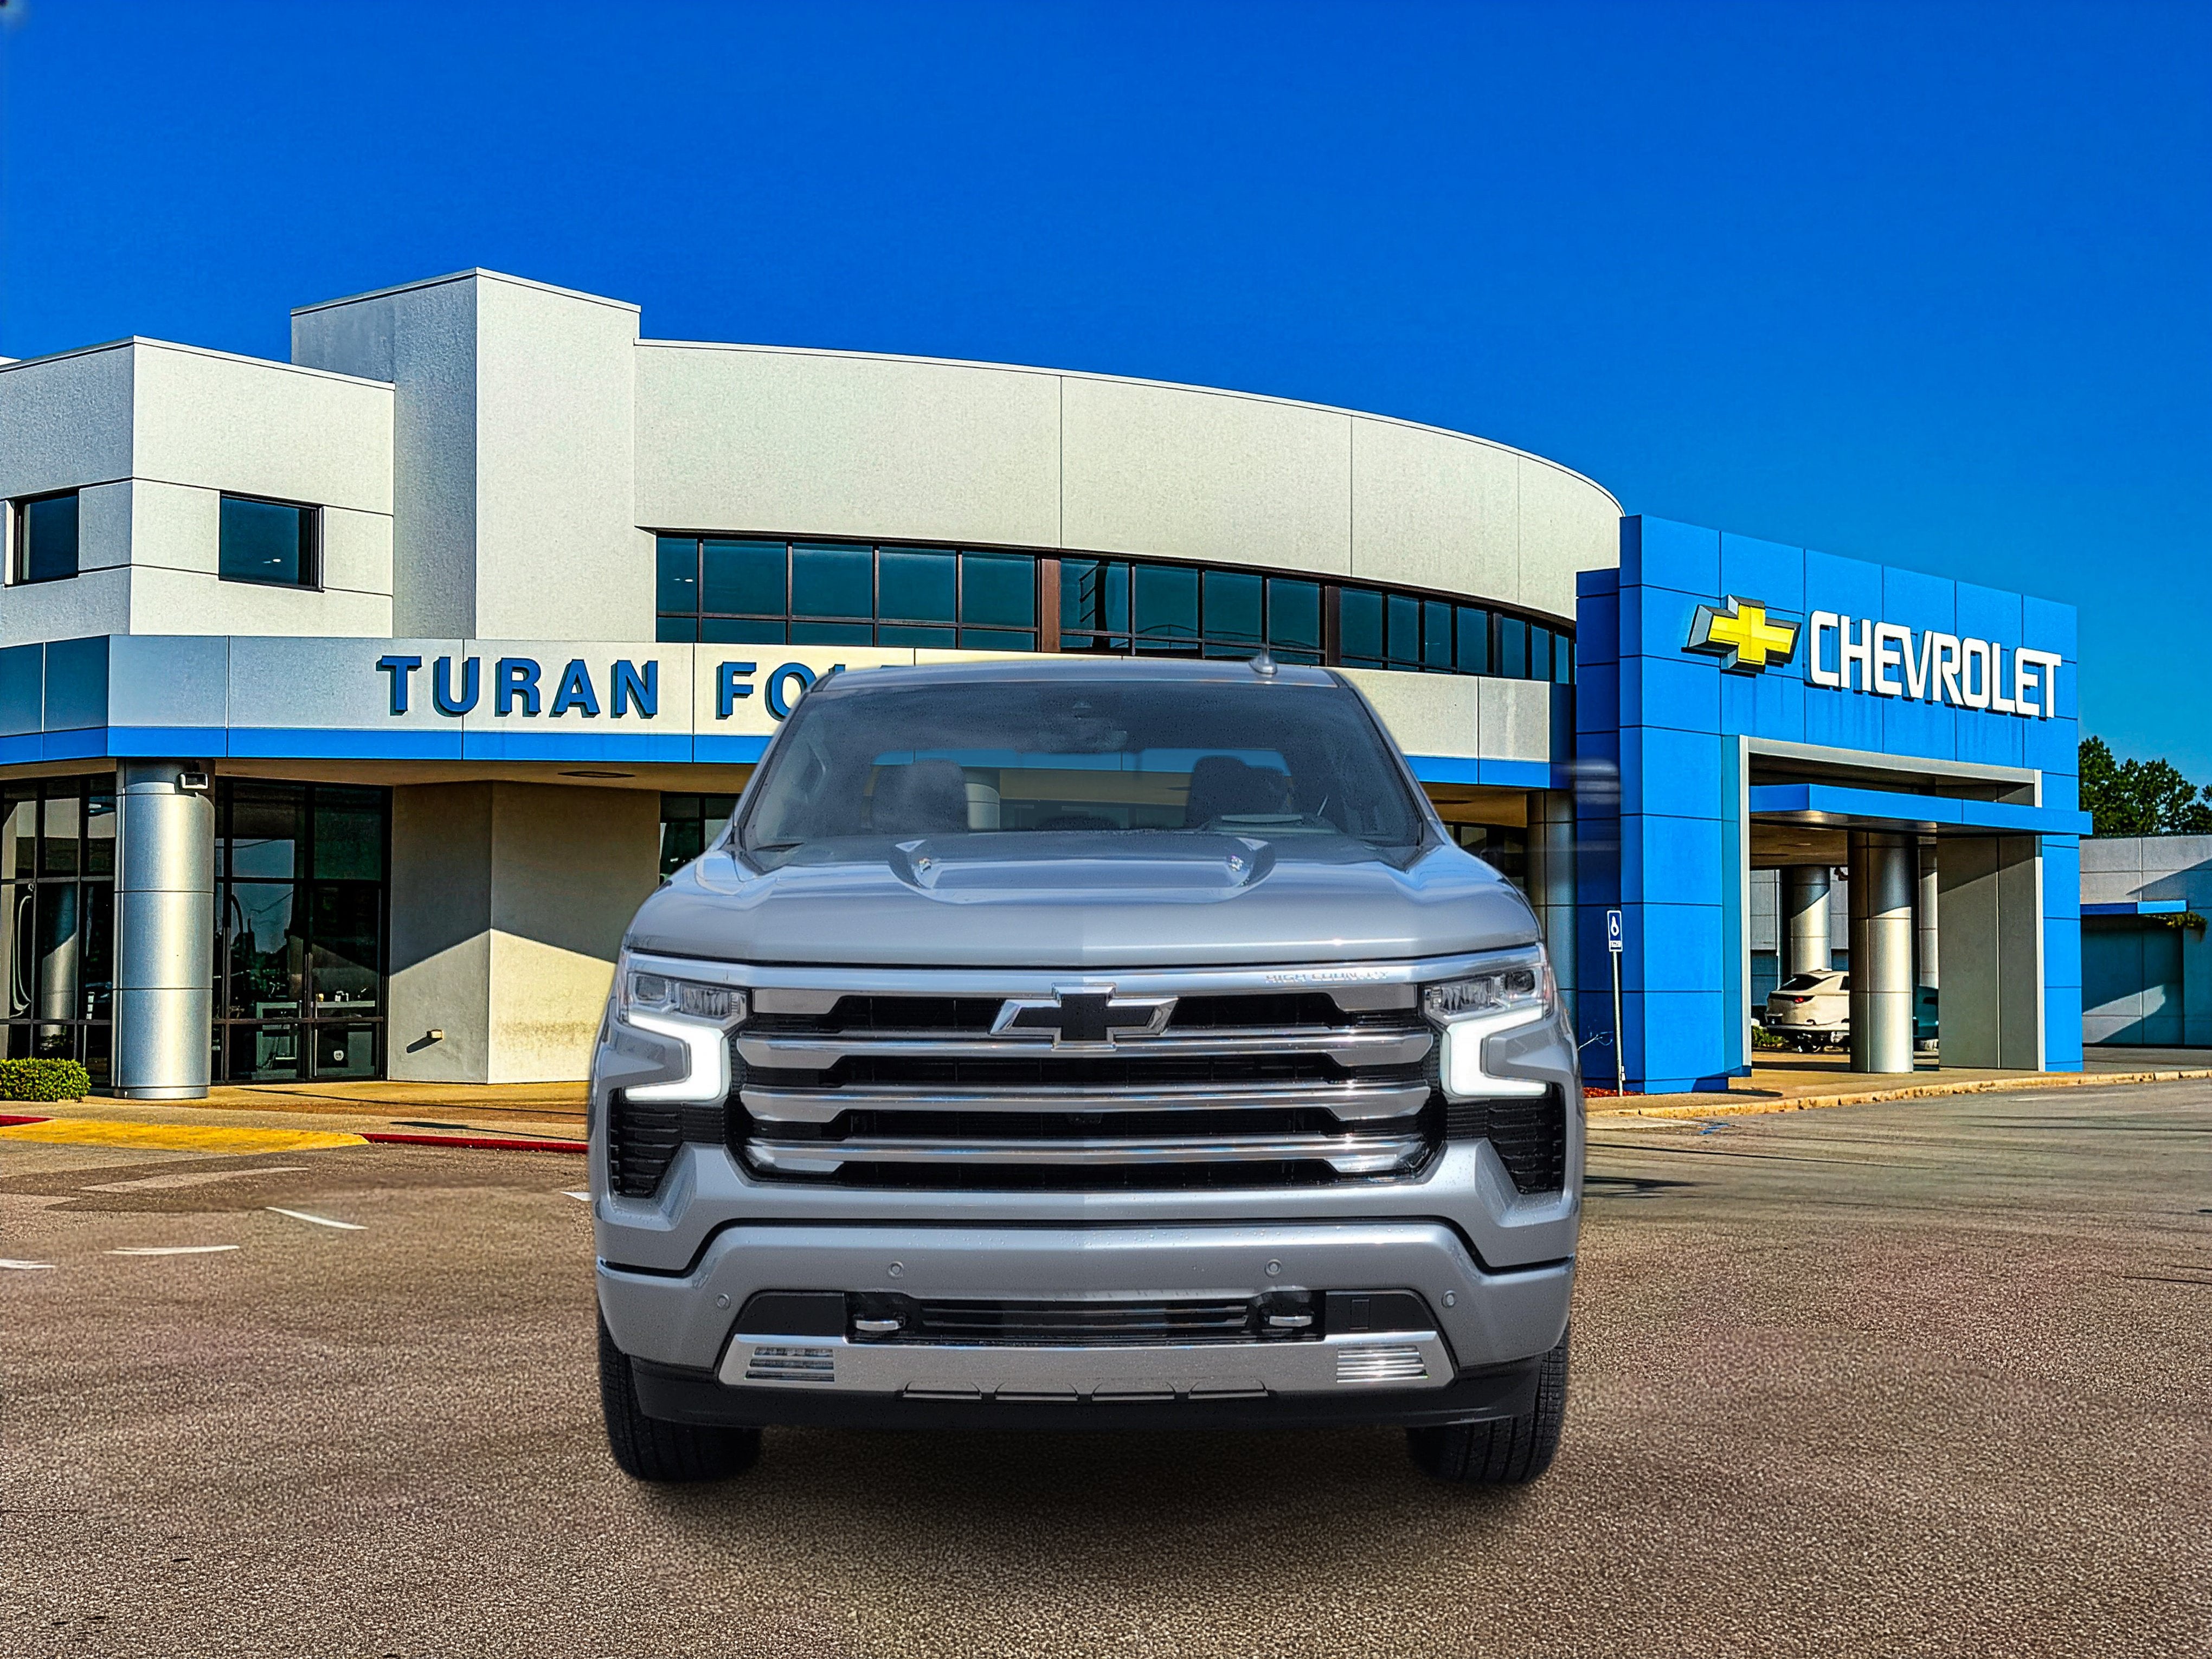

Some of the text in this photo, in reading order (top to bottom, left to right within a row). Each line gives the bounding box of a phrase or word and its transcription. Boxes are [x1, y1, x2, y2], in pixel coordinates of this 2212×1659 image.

[376, 655, 658, 719] TURAN
[1806, 610, 2062, 719] CHEVROLET
[1310, 971, 1388, 982] COUNRY
